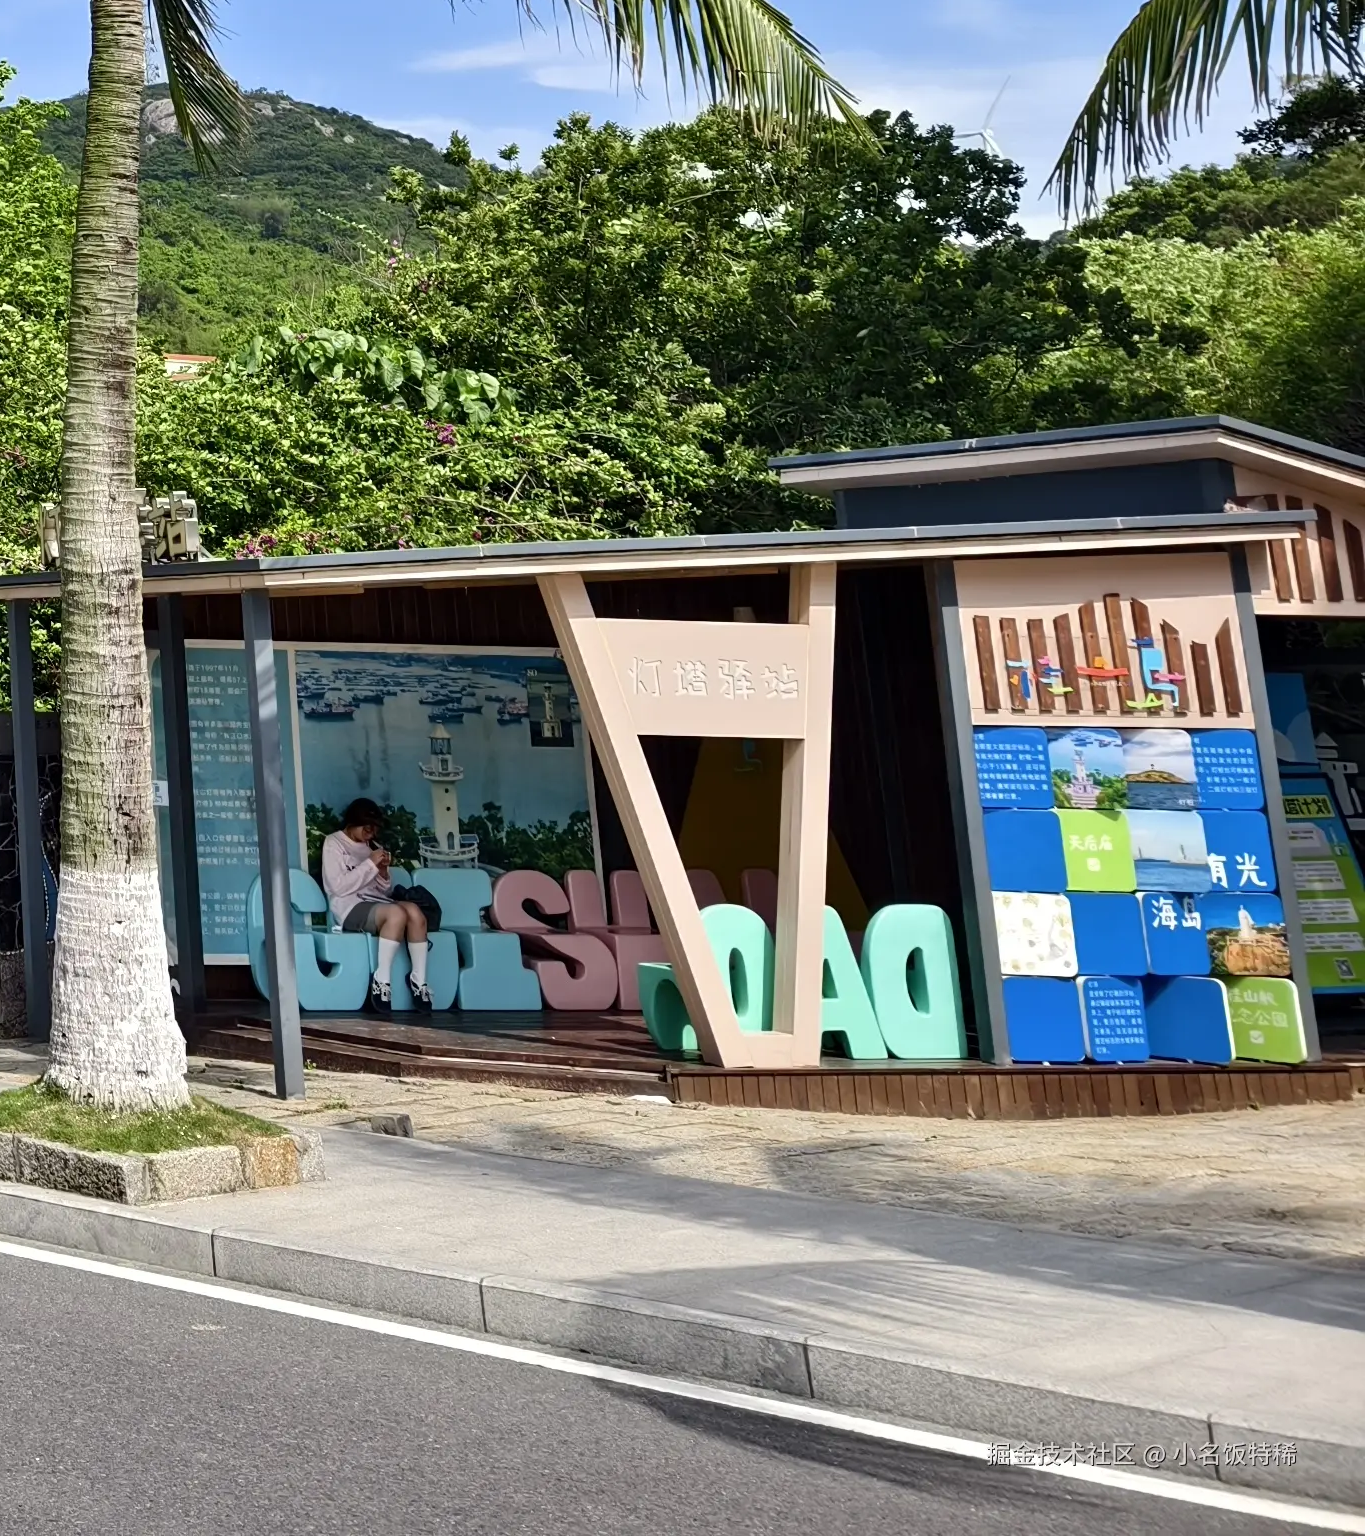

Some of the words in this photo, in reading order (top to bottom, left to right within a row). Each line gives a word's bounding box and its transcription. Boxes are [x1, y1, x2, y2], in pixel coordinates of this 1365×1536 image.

[627, 656, 799, 701] 灯塔驿站
[1207, 852, 1268, 889] 有光
[1151, 896, 1202, 930] 海岛
